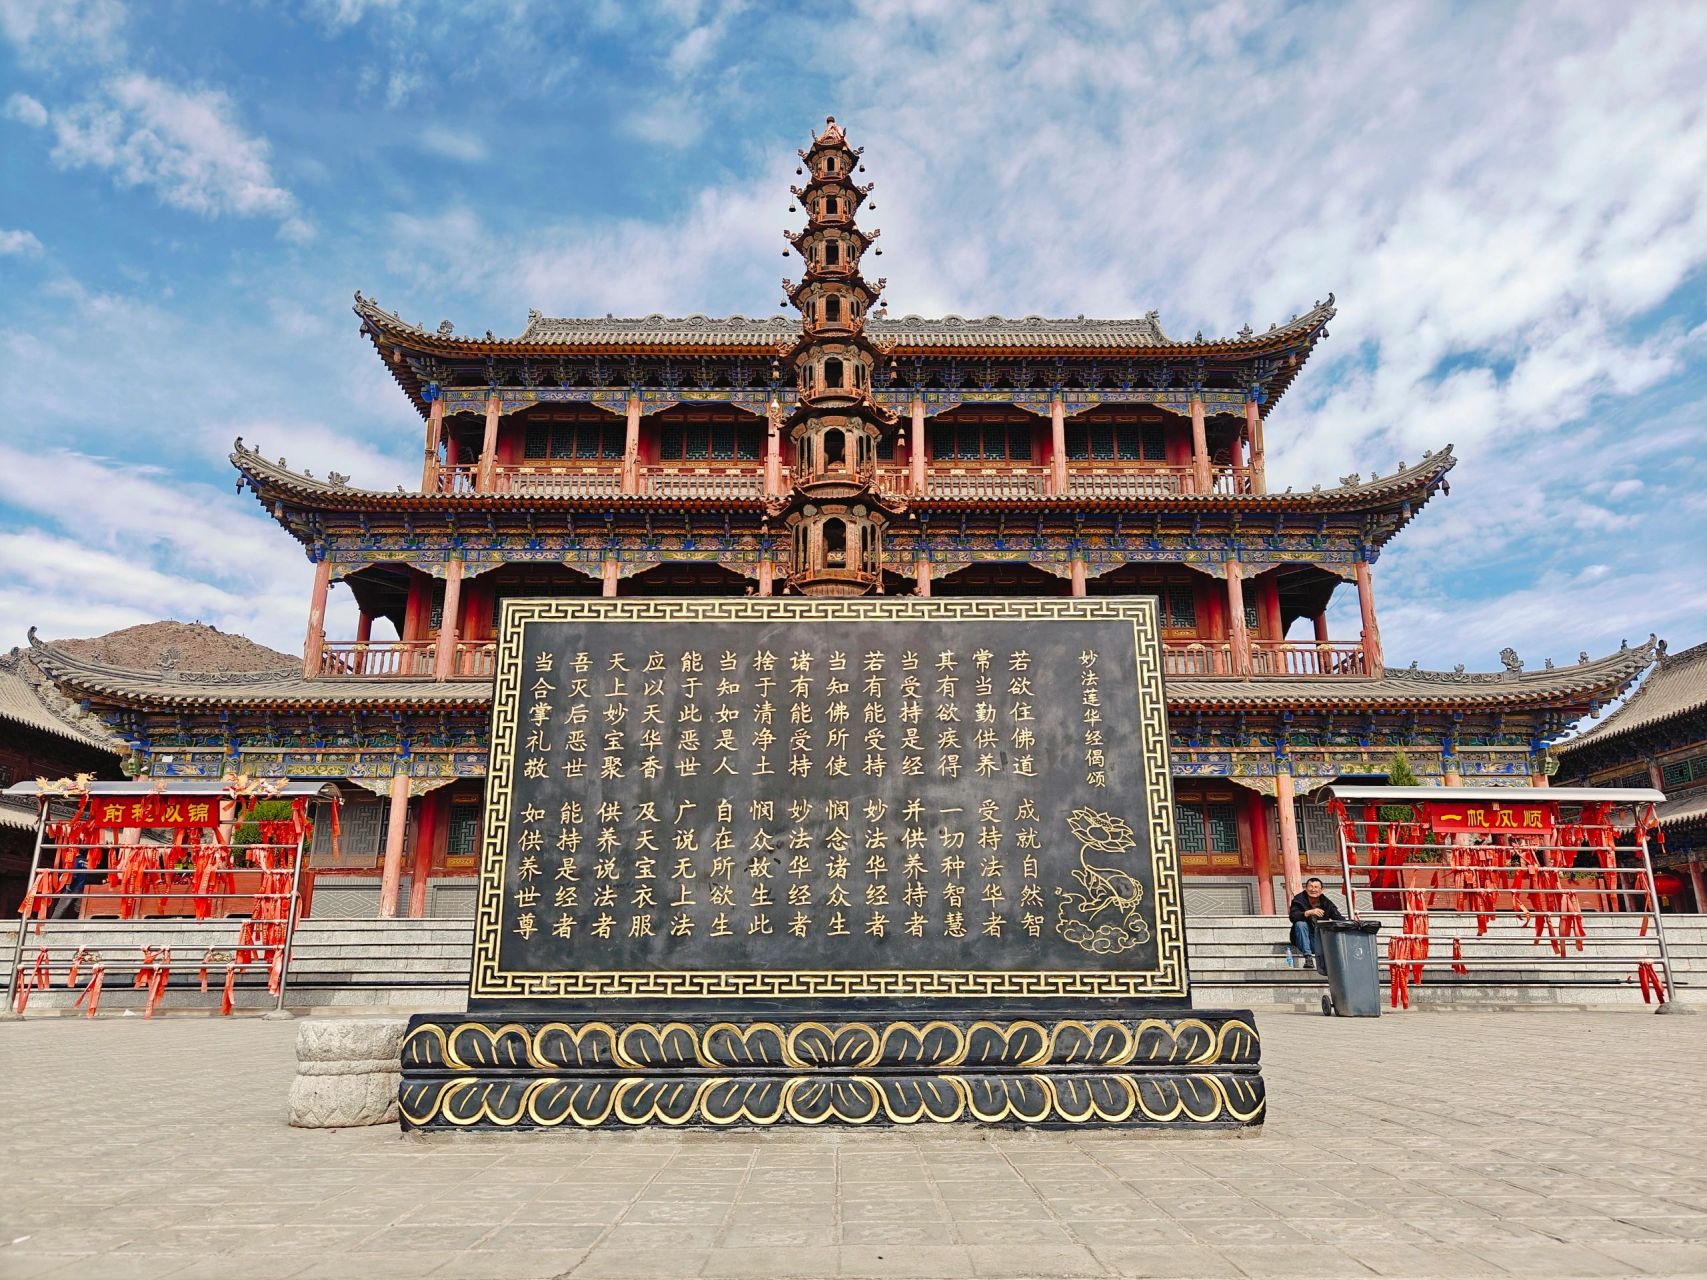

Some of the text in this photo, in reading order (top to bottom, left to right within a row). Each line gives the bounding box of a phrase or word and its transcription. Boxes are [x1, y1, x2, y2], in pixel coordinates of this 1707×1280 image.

[512, 651, 555, 941] 当合掌礼敬 如供养世尊
[552, 652, 593, 939] 吾灭后恶世 能持是经者
[591, 652, 631, 939] 天上妙宝聚 供养说法者
[628, 650, 667, 938] 应以天华香 及天宝衣服
[670, 650, 704, 937] 能于此恶世 广说无上法
[709, 650, 741, 937] 当知如是人 自在所欲生
[786, 649, 815, 938] 诸有能受持 妙法华经者
[824, 650, 851, 936] 当知佛所使 悯念诸众生
[861, 650, 890, 938] 若有能受持 妙法华经者
[898, 650, 929, 938] 当受持是经 并供养持者
[934, 648, 968, 938] 其有欲疾得 一切种智慧
[971, 648, 1006, 938] 常当勤供养 受持法华者
[1007, 649, 1045, 938] 若欲住佛道 成就自然智
[1078, 649, 1106, 788] 妙法莲华经偈颂
[1440, 808, 1543, 828] 一帆风顺
[747, 799, 775, 935] 悯众故生此
